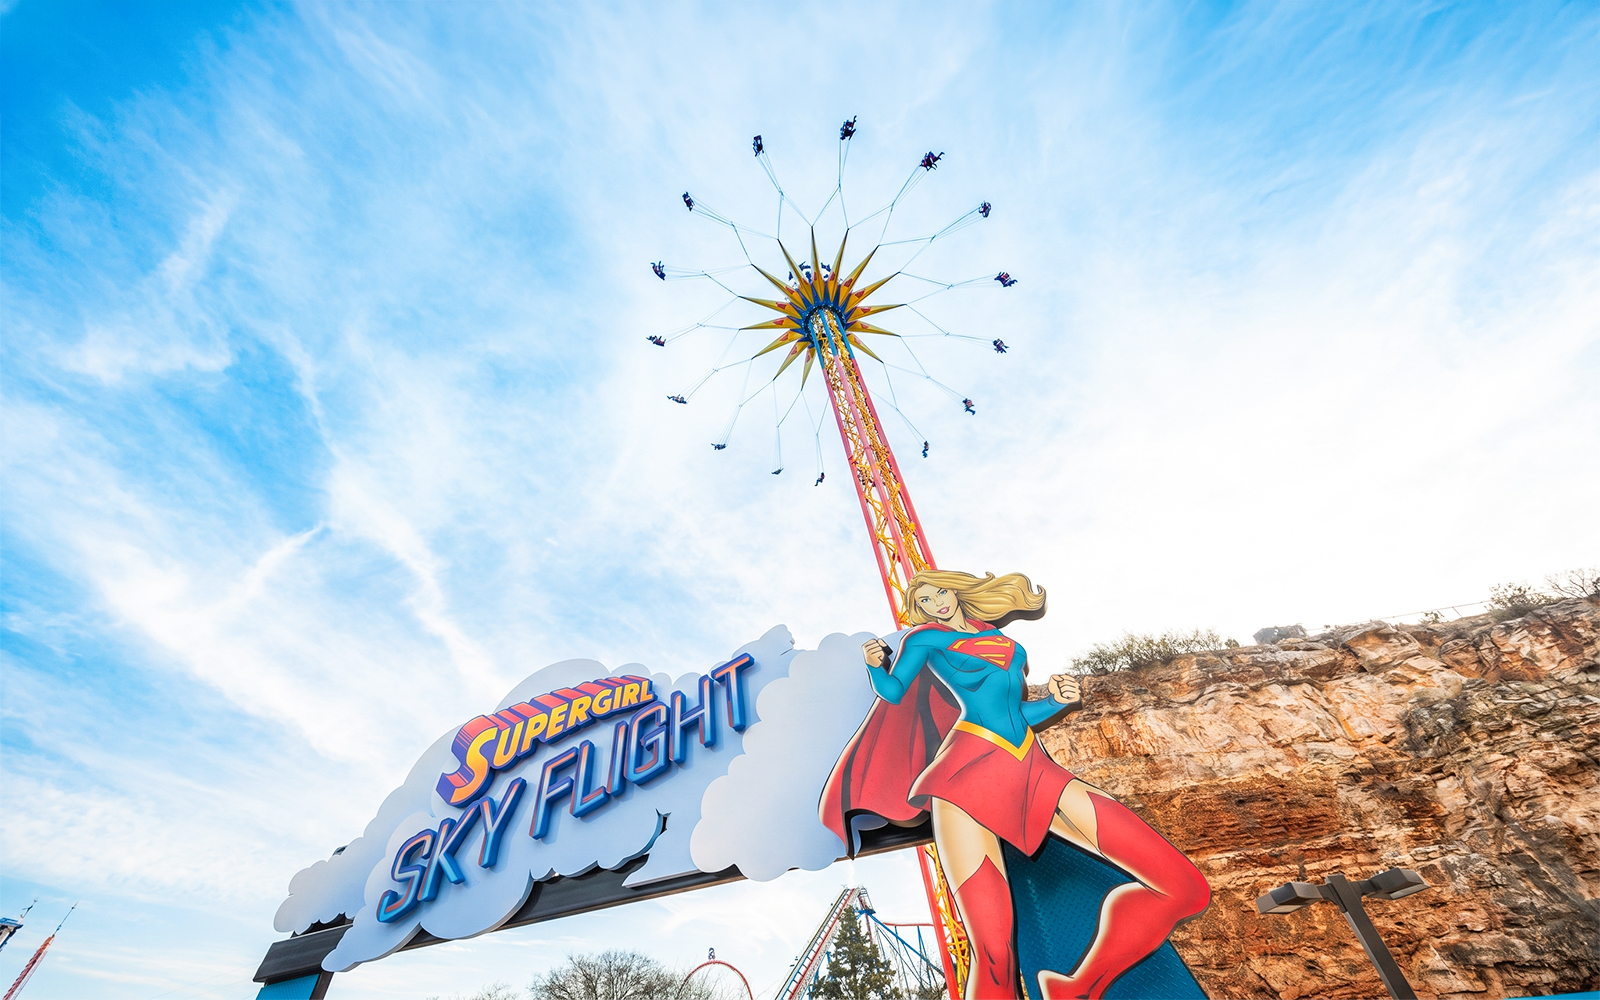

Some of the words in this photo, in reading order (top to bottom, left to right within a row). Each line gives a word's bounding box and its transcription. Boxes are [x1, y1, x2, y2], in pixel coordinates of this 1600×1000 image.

[376, 777, 528, 924] SKY
[529, 652, 755, 840] FLIGHT
[438, 675, 657, 806] SUPERGIRL
